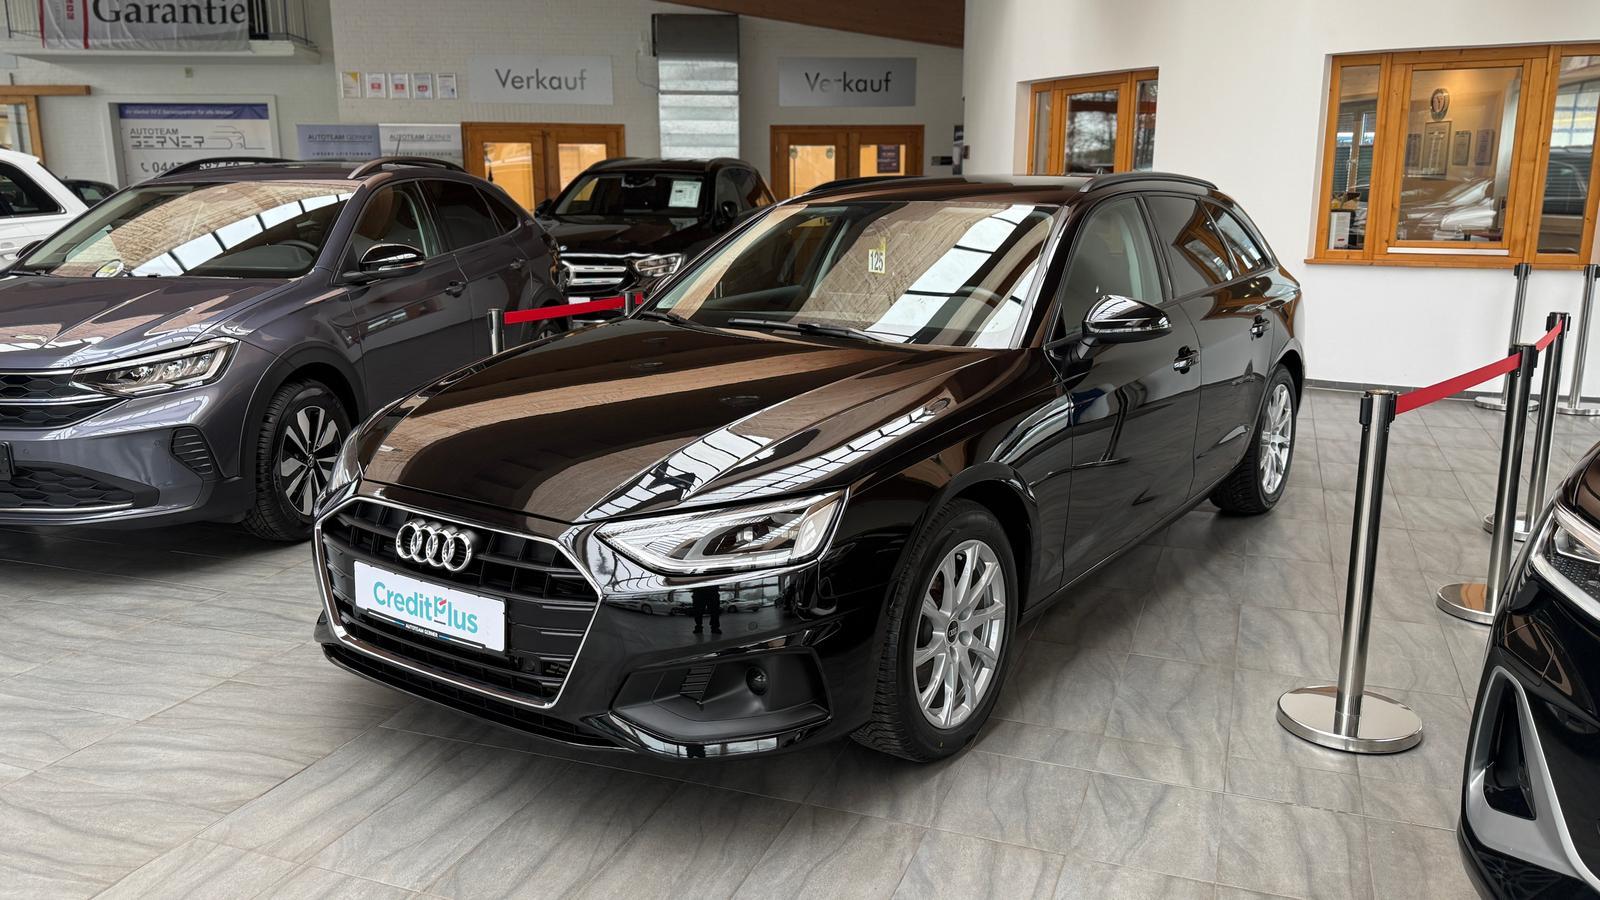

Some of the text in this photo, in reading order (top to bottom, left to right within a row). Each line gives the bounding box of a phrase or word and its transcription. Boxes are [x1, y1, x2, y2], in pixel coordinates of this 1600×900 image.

[93, 0, 246, 24] Garantie
[495, 68, 587, 91] Verkauf
[804, 71, 892, 93] Verkauf
[870, 250, 884, 271] 125
[373, 581, 478, 634] CreditPlus
